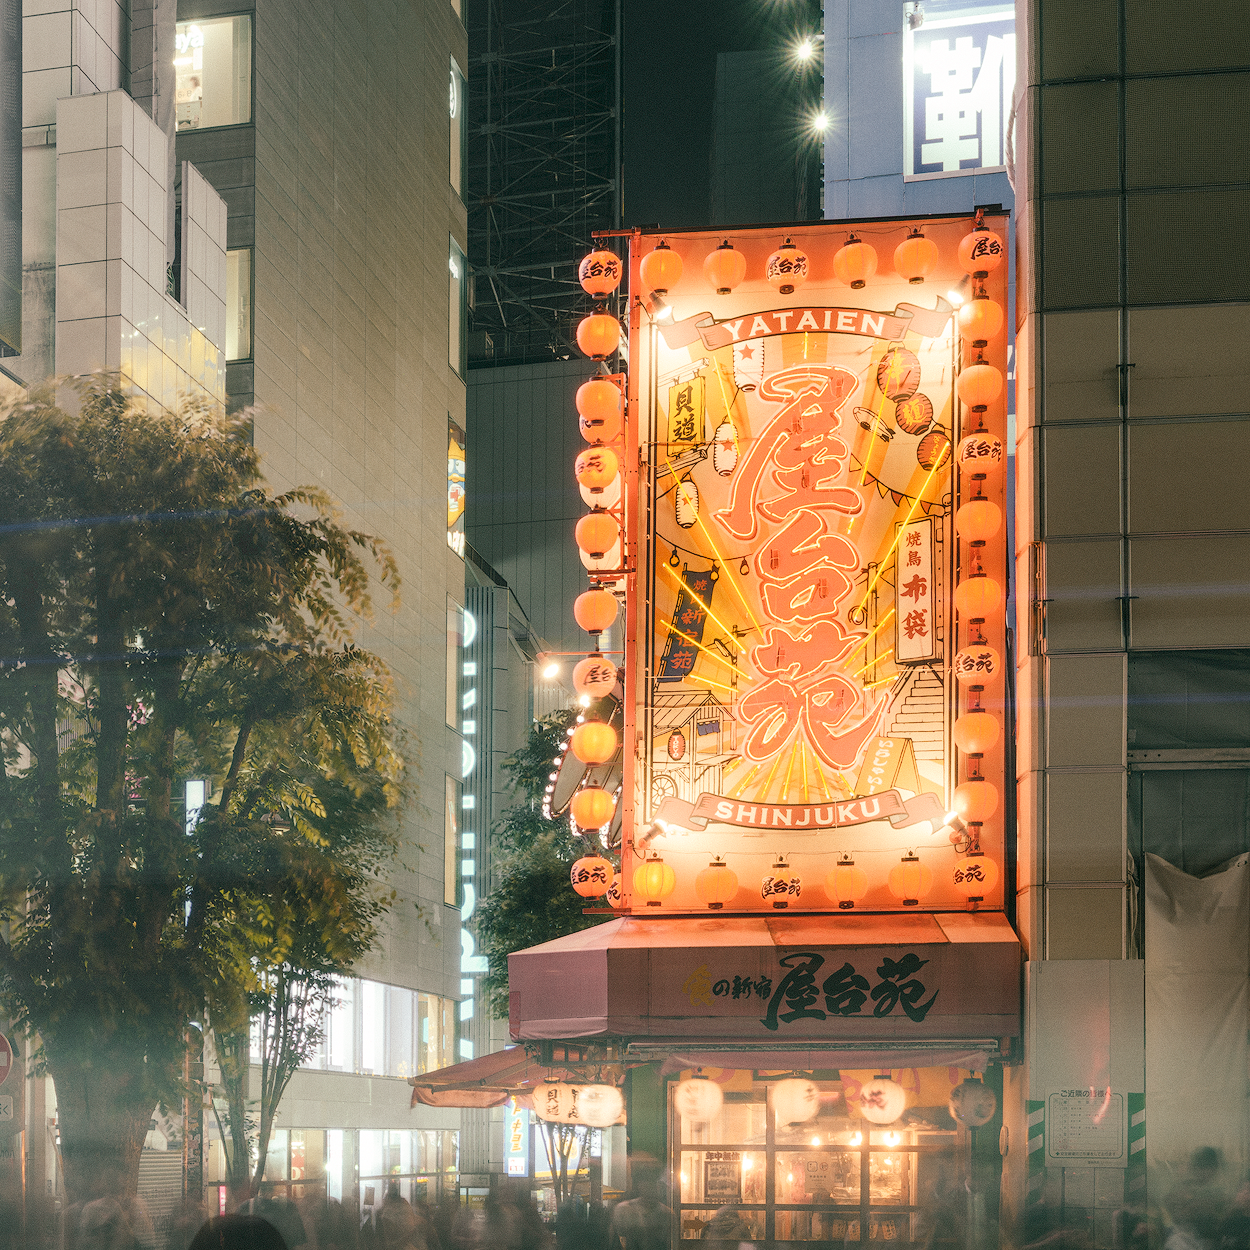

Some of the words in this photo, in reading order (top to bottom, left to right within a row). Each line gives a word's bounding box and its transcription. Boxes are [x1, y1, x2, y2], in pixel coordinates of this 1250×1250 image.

[766, 256, 808, 279] 屋台苑
[722, 309, 887, 343] YATAIEN
[673, 385, 698, 443] 貝道
[712, 363, 891, 771] 屋台苑
[900, 530, 929, 640] 焼鳥布袋
[715, 798, 881, 826] SHINJUKU
[760, 952, 940, 1031] 屋台苑
